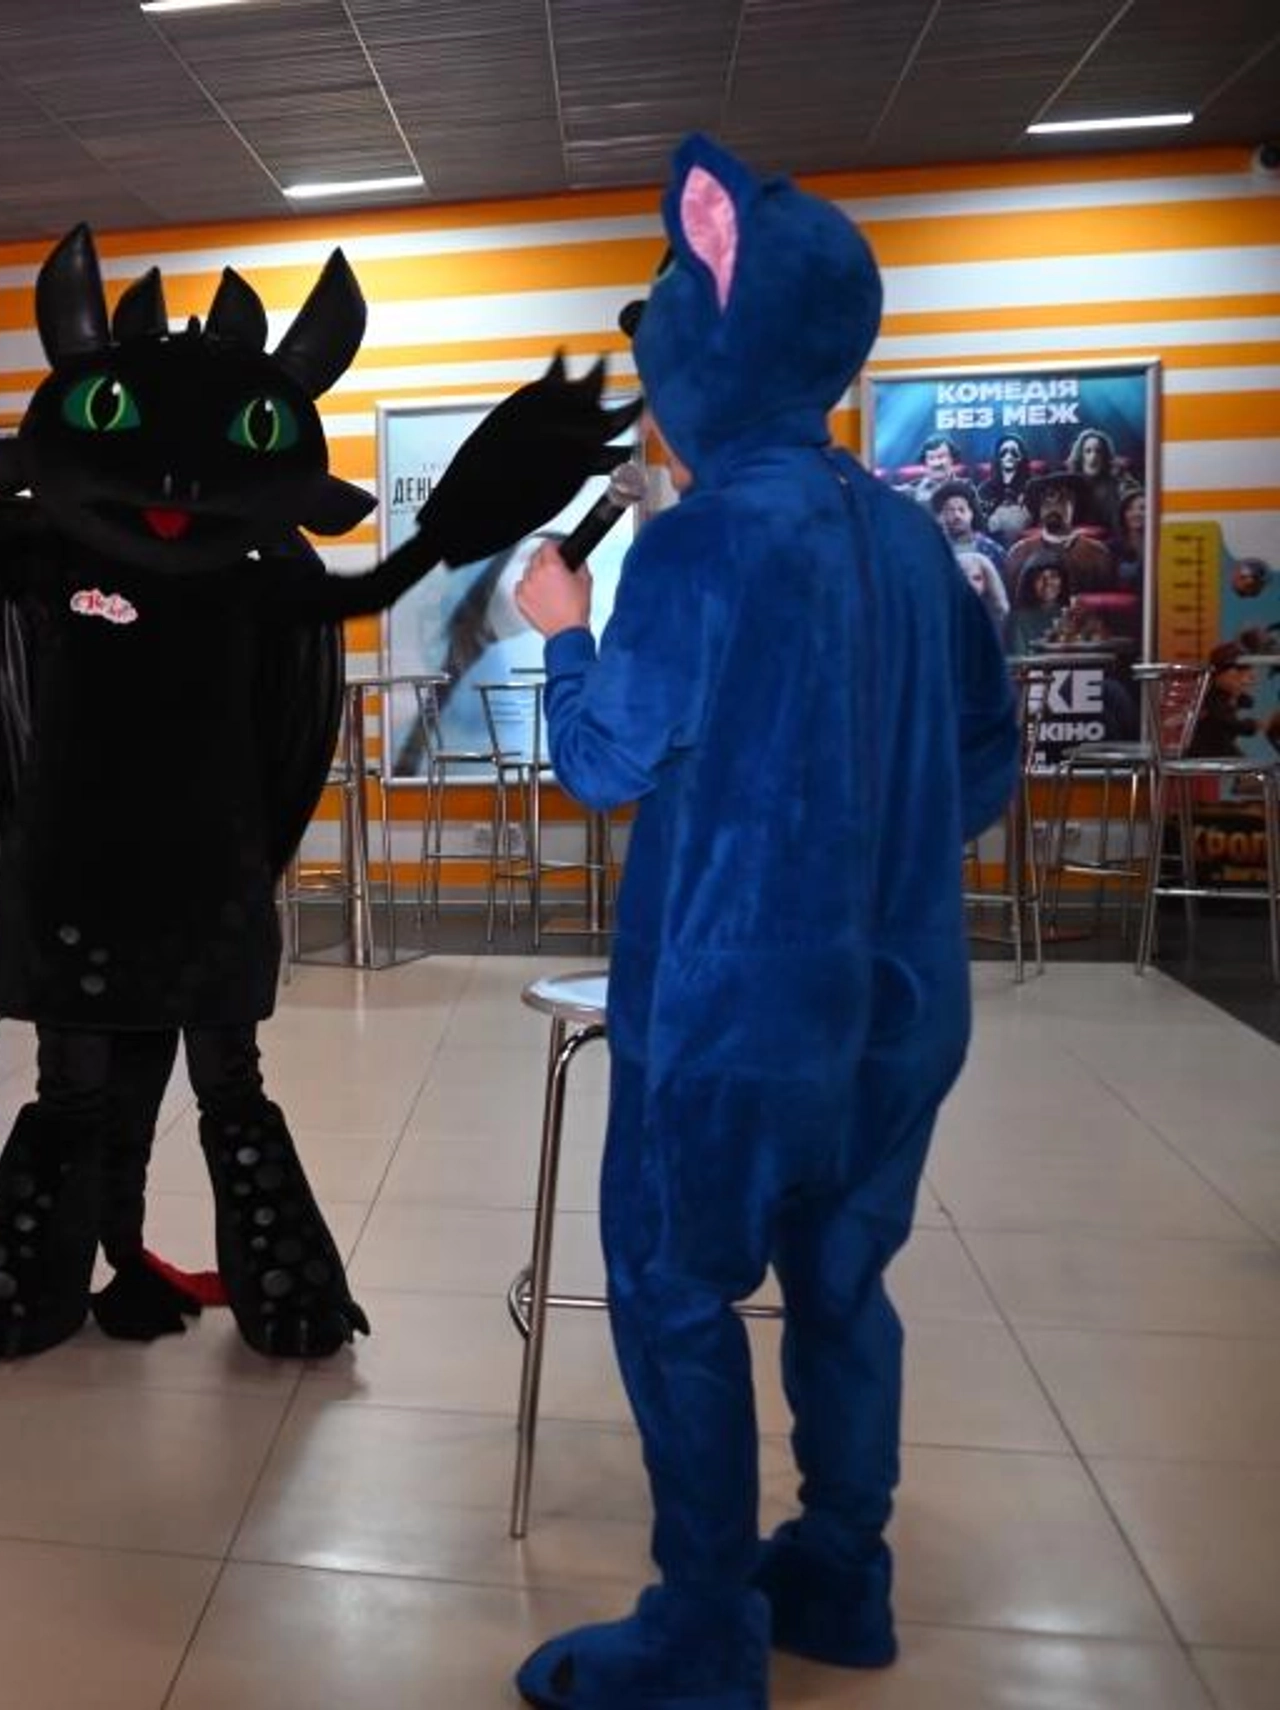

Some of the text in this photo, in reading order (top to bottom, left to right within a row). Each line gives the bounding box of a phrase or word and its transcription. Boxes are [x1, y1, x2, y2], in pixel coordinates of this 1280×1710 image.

[936, 379, 1079, 404] КОМЕДІЯ
[936, 402, 1079, 430] БЕЗ МЕЖ
[1039, 721, 1105, 741] КІНО
